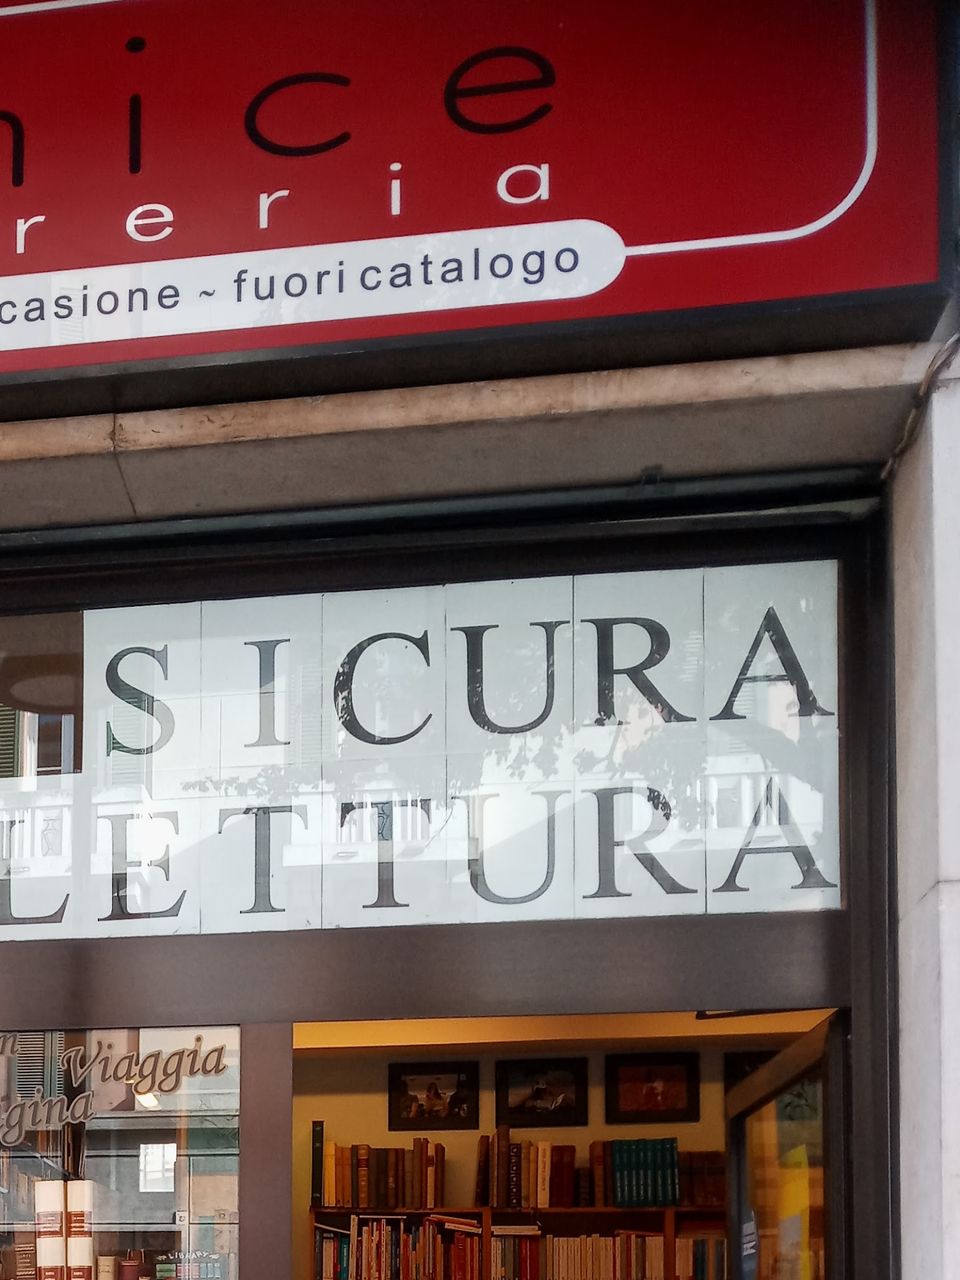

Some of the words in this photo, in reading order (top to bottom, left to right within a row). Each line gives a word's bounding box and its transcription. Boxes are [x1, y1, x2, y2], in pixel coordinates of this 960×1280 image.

[233, 259, 346, 304] fuori
[360, 244, 581, 291] catalogo
[105, 606, 836, 757] SICURA
[61, 1035, 228, 1095] Viaggia
